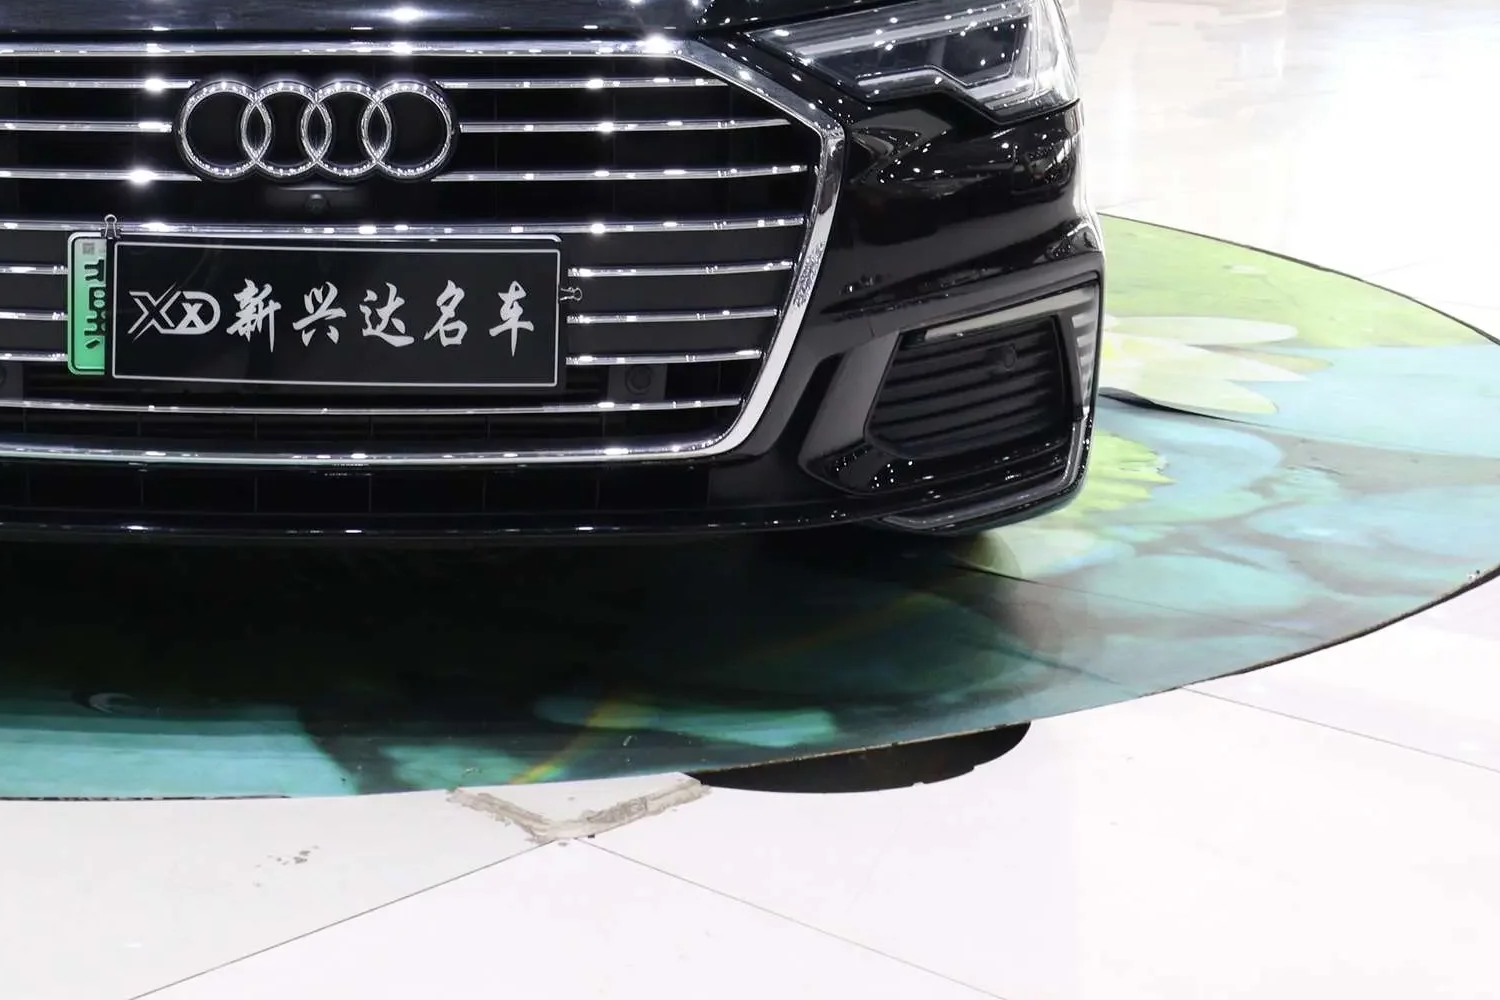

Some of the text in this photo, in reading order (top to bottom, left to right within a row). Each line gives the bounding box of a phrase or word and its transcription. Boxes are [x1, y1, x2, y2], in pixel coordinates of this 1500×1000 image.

[226, 277, 535, 357] 新兴达名车
